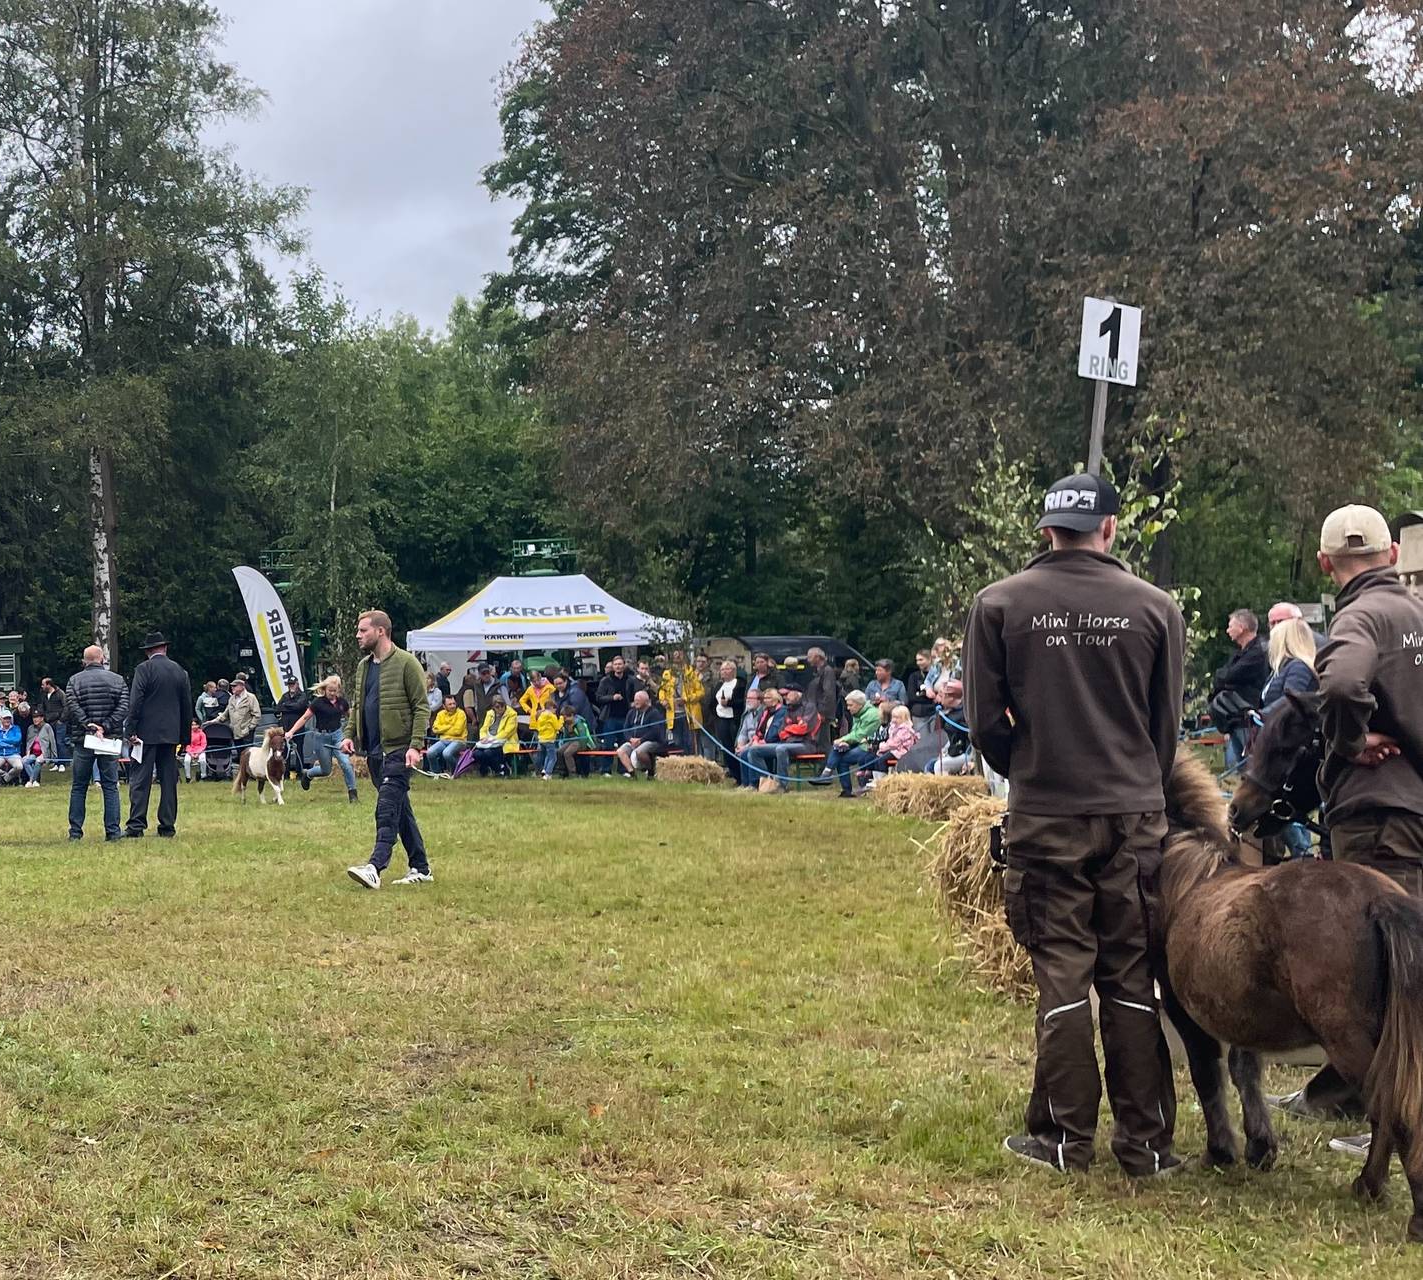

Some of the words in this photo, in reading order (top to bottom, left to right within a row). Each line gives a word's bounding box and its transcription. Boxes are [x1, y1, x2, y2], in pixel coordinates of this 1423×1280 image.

[1099, 306, 1122, 372] 1
[1089, 354, 1129, 380] RING
[483, 604, 606, 617] KÄRCHER
[1031, 612, 1070, 630] Mini
[1077, 613, 1130, 629] Horse
[1045, 635, 1068, 647] on
[1072, 631, 1118, 647] Tour
[1402, 631, 1423, 649] Min
